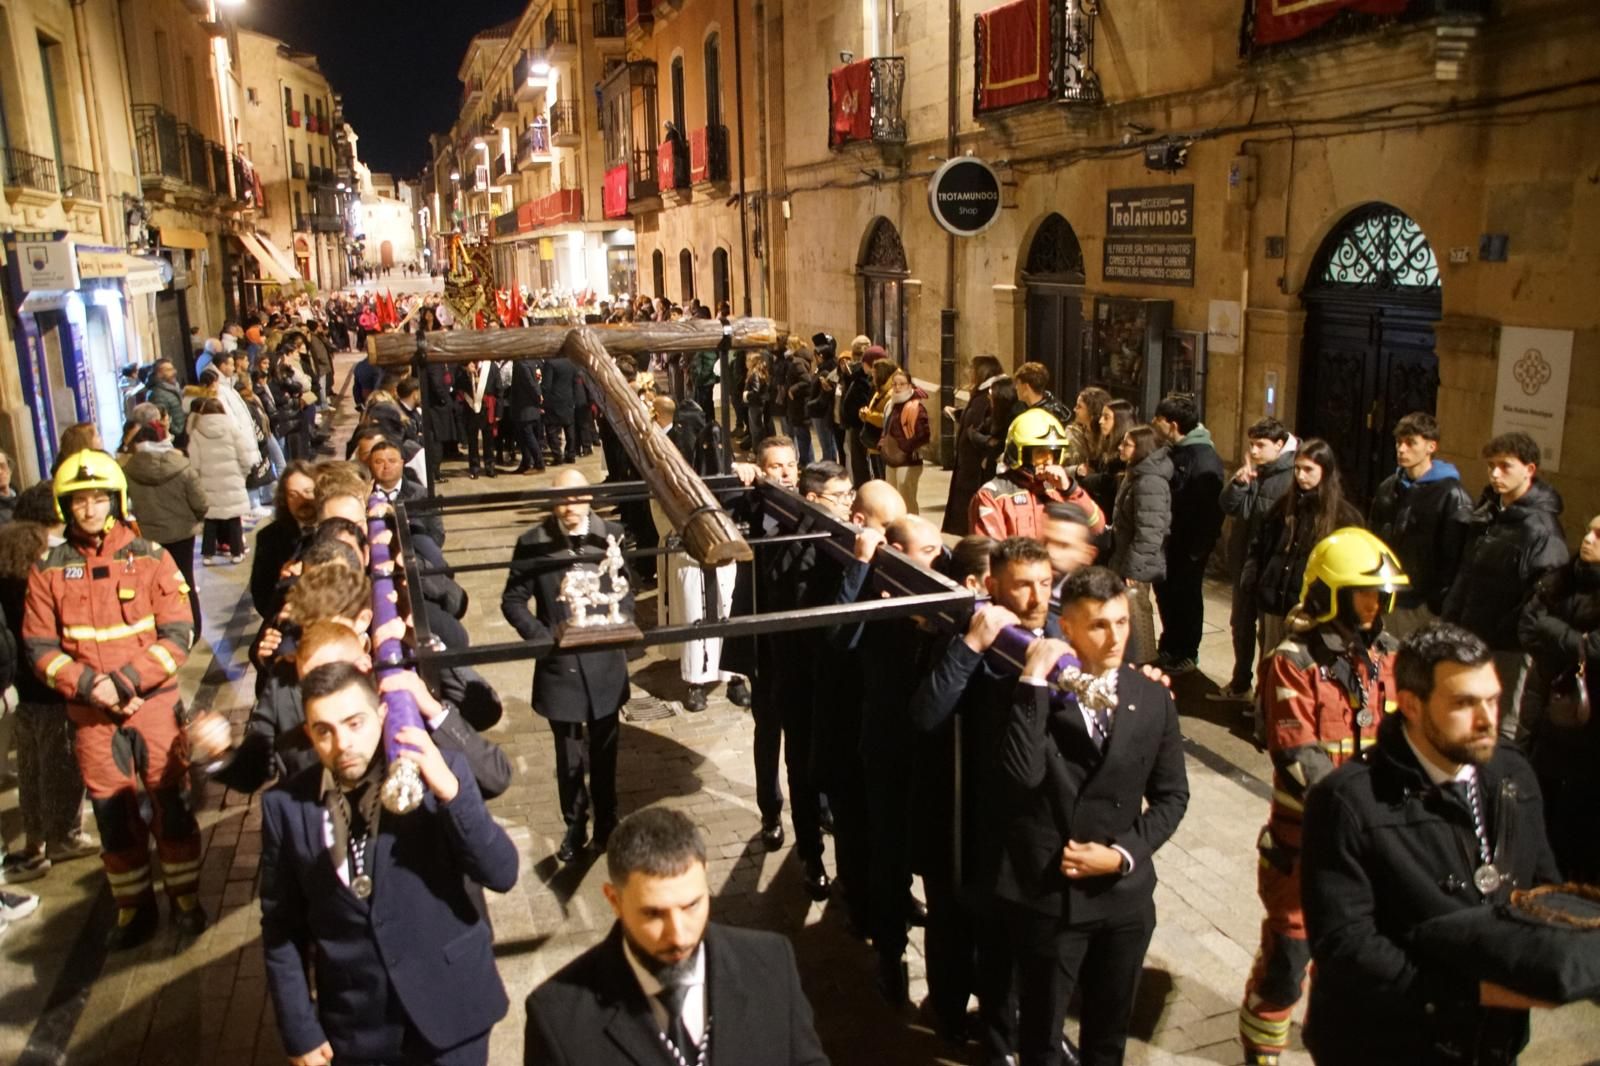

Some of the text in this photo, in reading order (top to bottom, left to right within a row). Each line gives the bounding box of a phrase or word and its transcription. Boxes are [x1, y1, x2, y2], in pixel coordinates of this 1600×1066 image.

[938, 192, 998, 201] TROTAMUNDOS
[959, 206, 978, 216] Shop
[65, 567, 83, 579] 220
